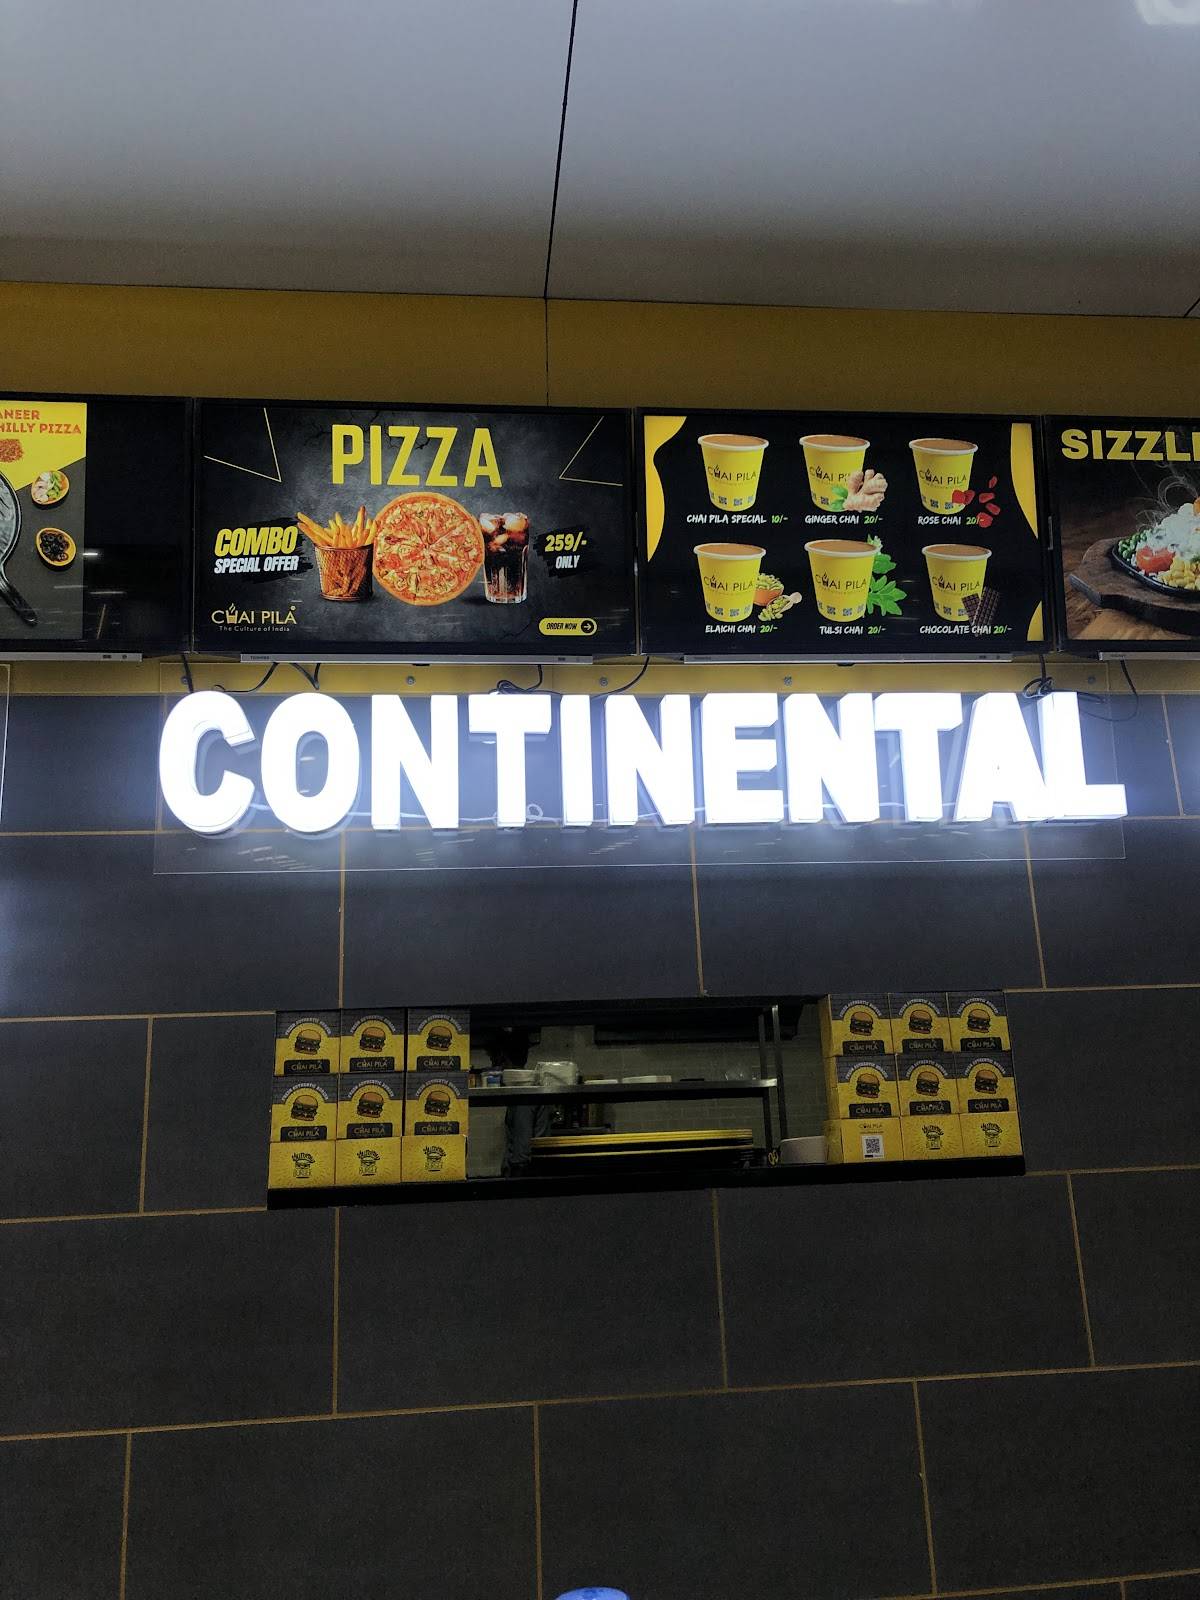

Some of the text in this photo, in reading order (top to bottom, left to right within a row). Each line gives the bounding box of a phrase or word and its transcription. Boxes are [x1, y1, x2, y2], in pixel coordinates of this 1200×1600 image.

[39, 423, 81, 434] PIZZA
[332, 424, 502, 488] PIZZA
[687, 514, 788, 524] CHAI PILA SPECIAL 10/-
[804, 515, 883, 525] GINGER CHAI 20/-
[917, 516, 940, 525] ROSE
[941, 516, 961, 525] CHAI
[214, 526, 298, 557] COMBO
[545, 531, 587, 552] 259/-
[214, 556, 299, 574] SPECIAL OFFER
[555, 555, 580, 569] ONLY
[546, 622, 564, 633] ORDER
[705, 625, 778, 633] ELAICHI CHAI 20/-
[819, 626, 887, 635] TULSI CHAI 20/-
[919, 625, 1013, 634] CHOCOLATE CHAI 20/-
[158, 690, 1127, 835] CONTINENTAL
